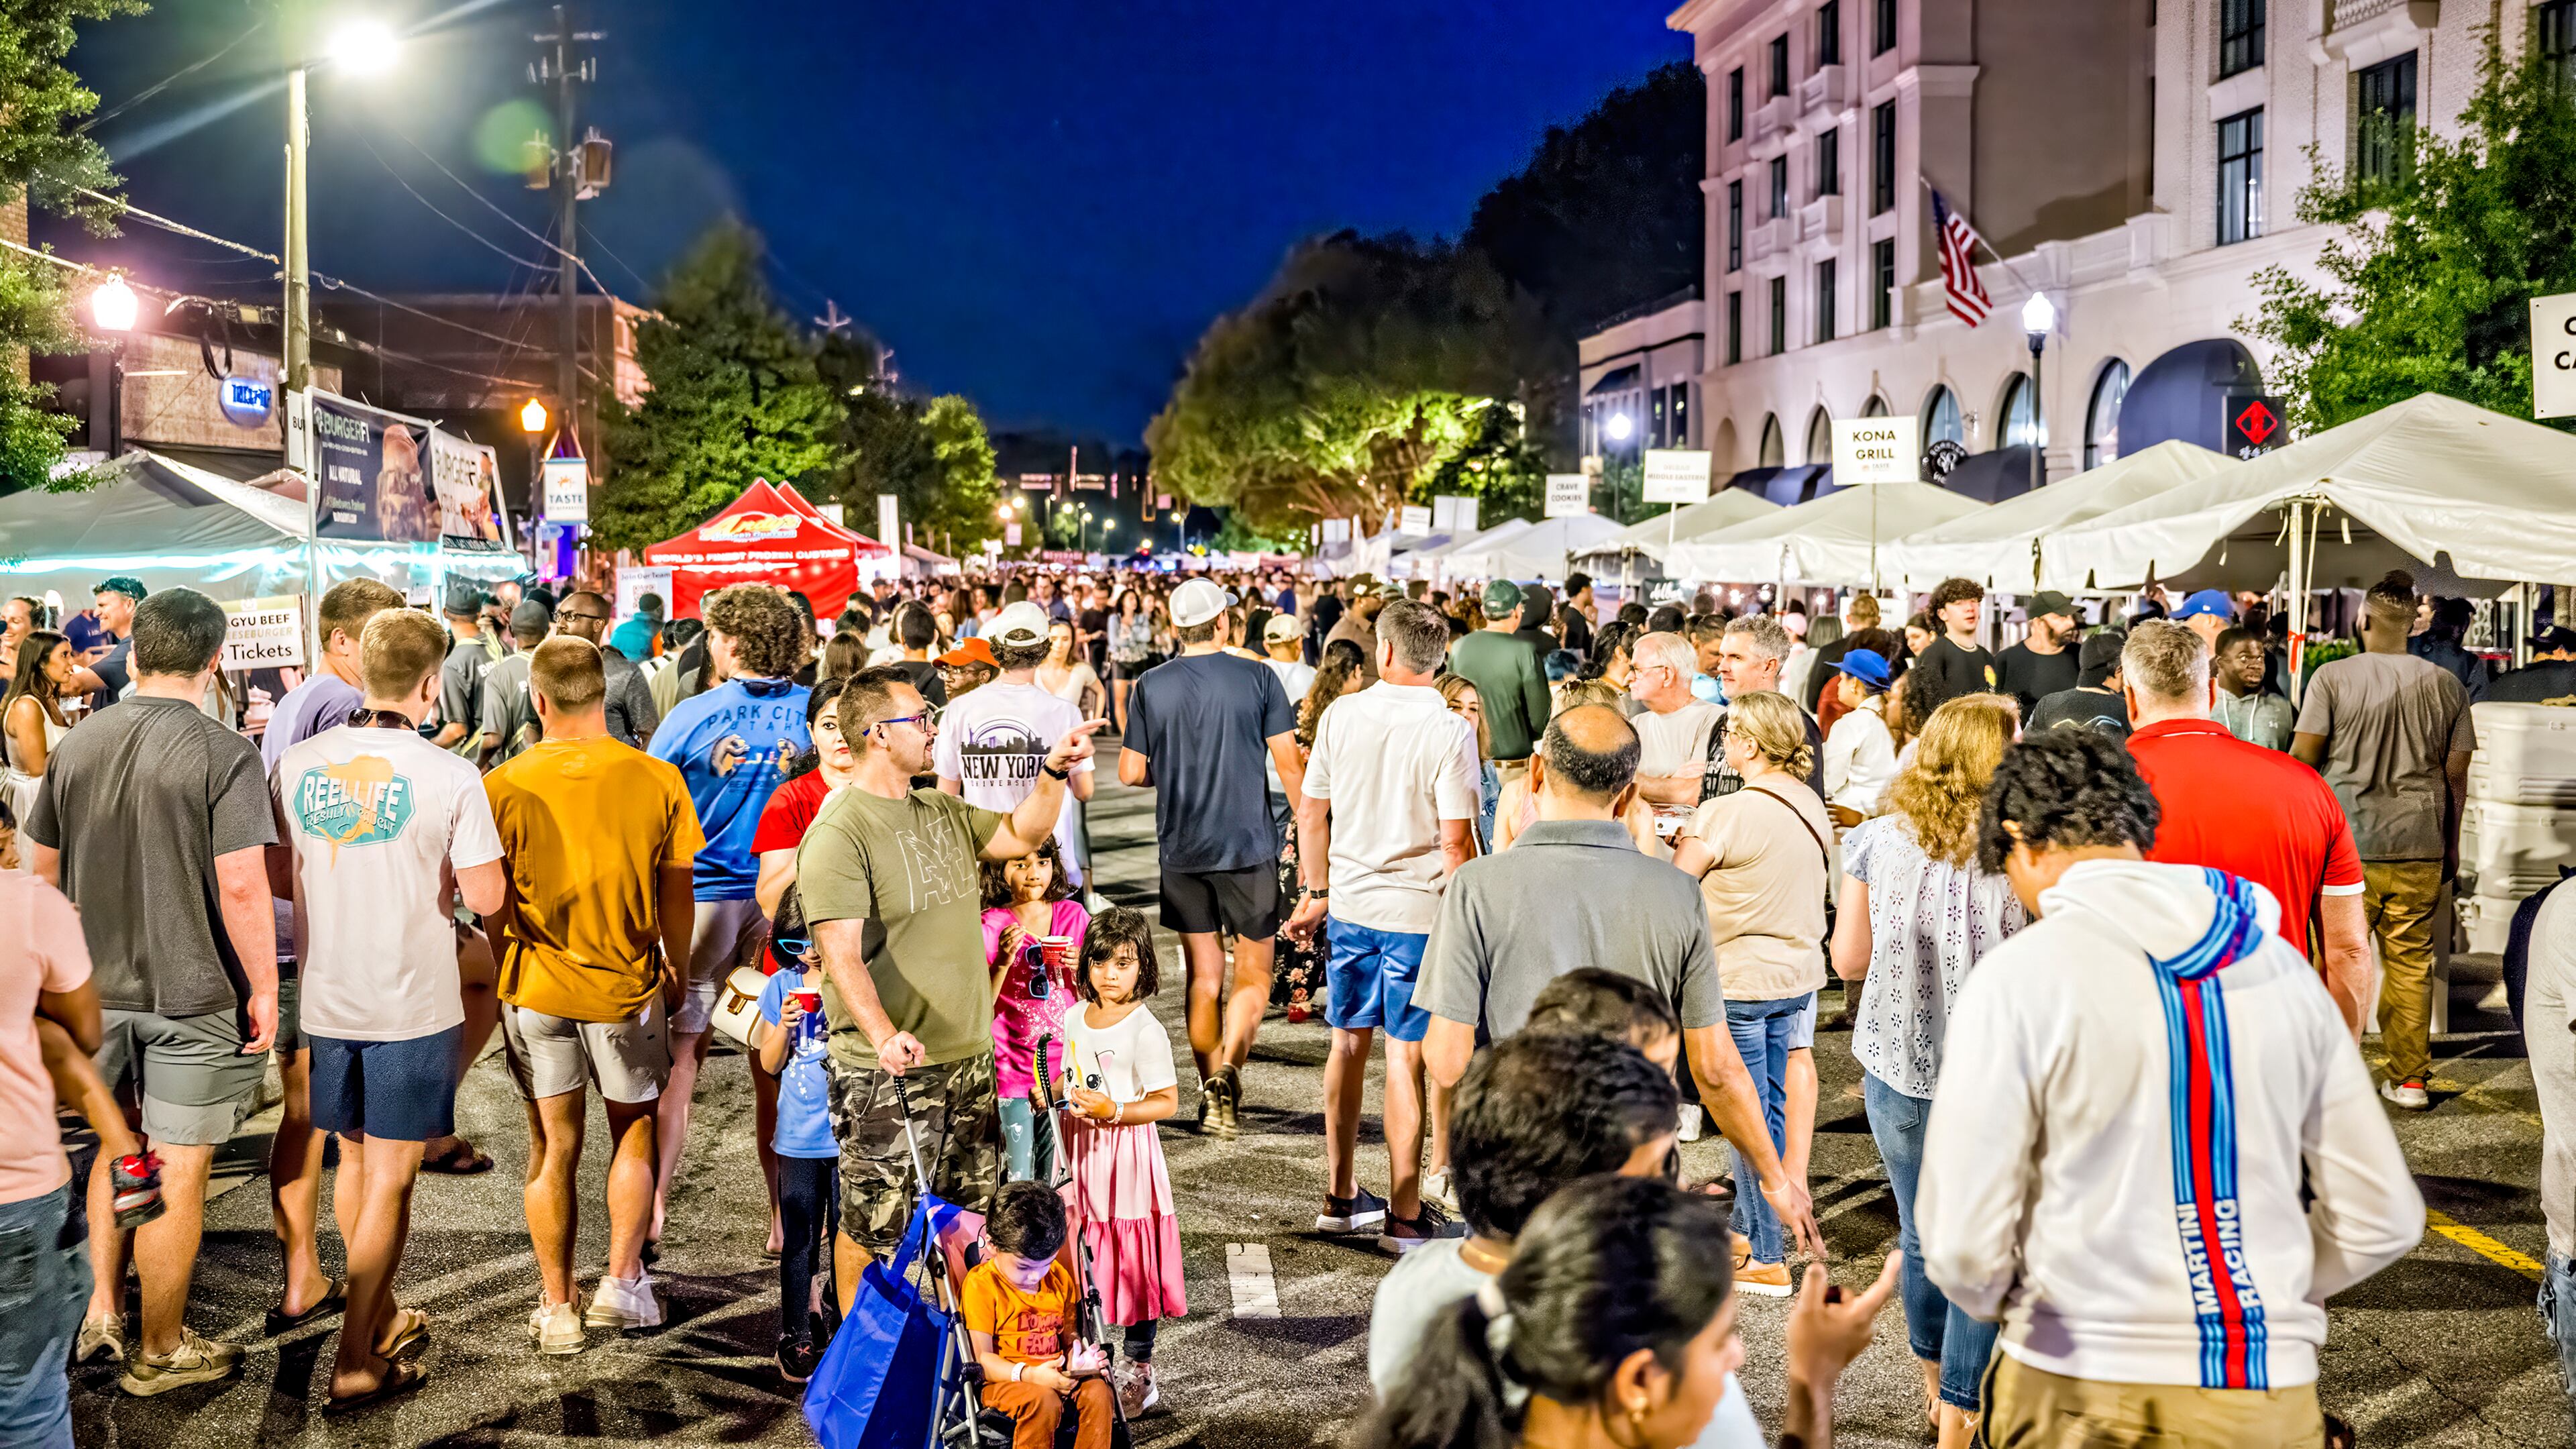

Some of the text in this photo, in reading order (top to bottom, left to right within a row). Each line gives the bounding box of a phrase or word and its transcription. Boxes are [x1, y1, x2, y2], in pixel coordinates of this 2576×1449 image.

[292, 416, 305, 431] BU
[323, 411, 370, 443] BURGERFI
[1853, 430, 1896, 441] KONA
[1856, 448, 1894, 460] GRILL
[1556, 483, 1578, 491] CRAVE
[549, 494, 583, 504] TASTE
[1551, 494, 1582, 502] COOKIES
[748, 551, 794, 560] FROZEN
[226, 613, 290, 627] GYU BEEF
[229, 642, 292, 661] Tickets
[706, 705, 805, 729] PARK CIT
[729, 720, 792, 731] UTAH
[961, 755, 1000, 779] NEW
[304, 775, 404, 822] REEL LIFE
[2176, 1203, 2221, 1316] MARTINI
[2214, 1199, 2261, 1310] RACING
